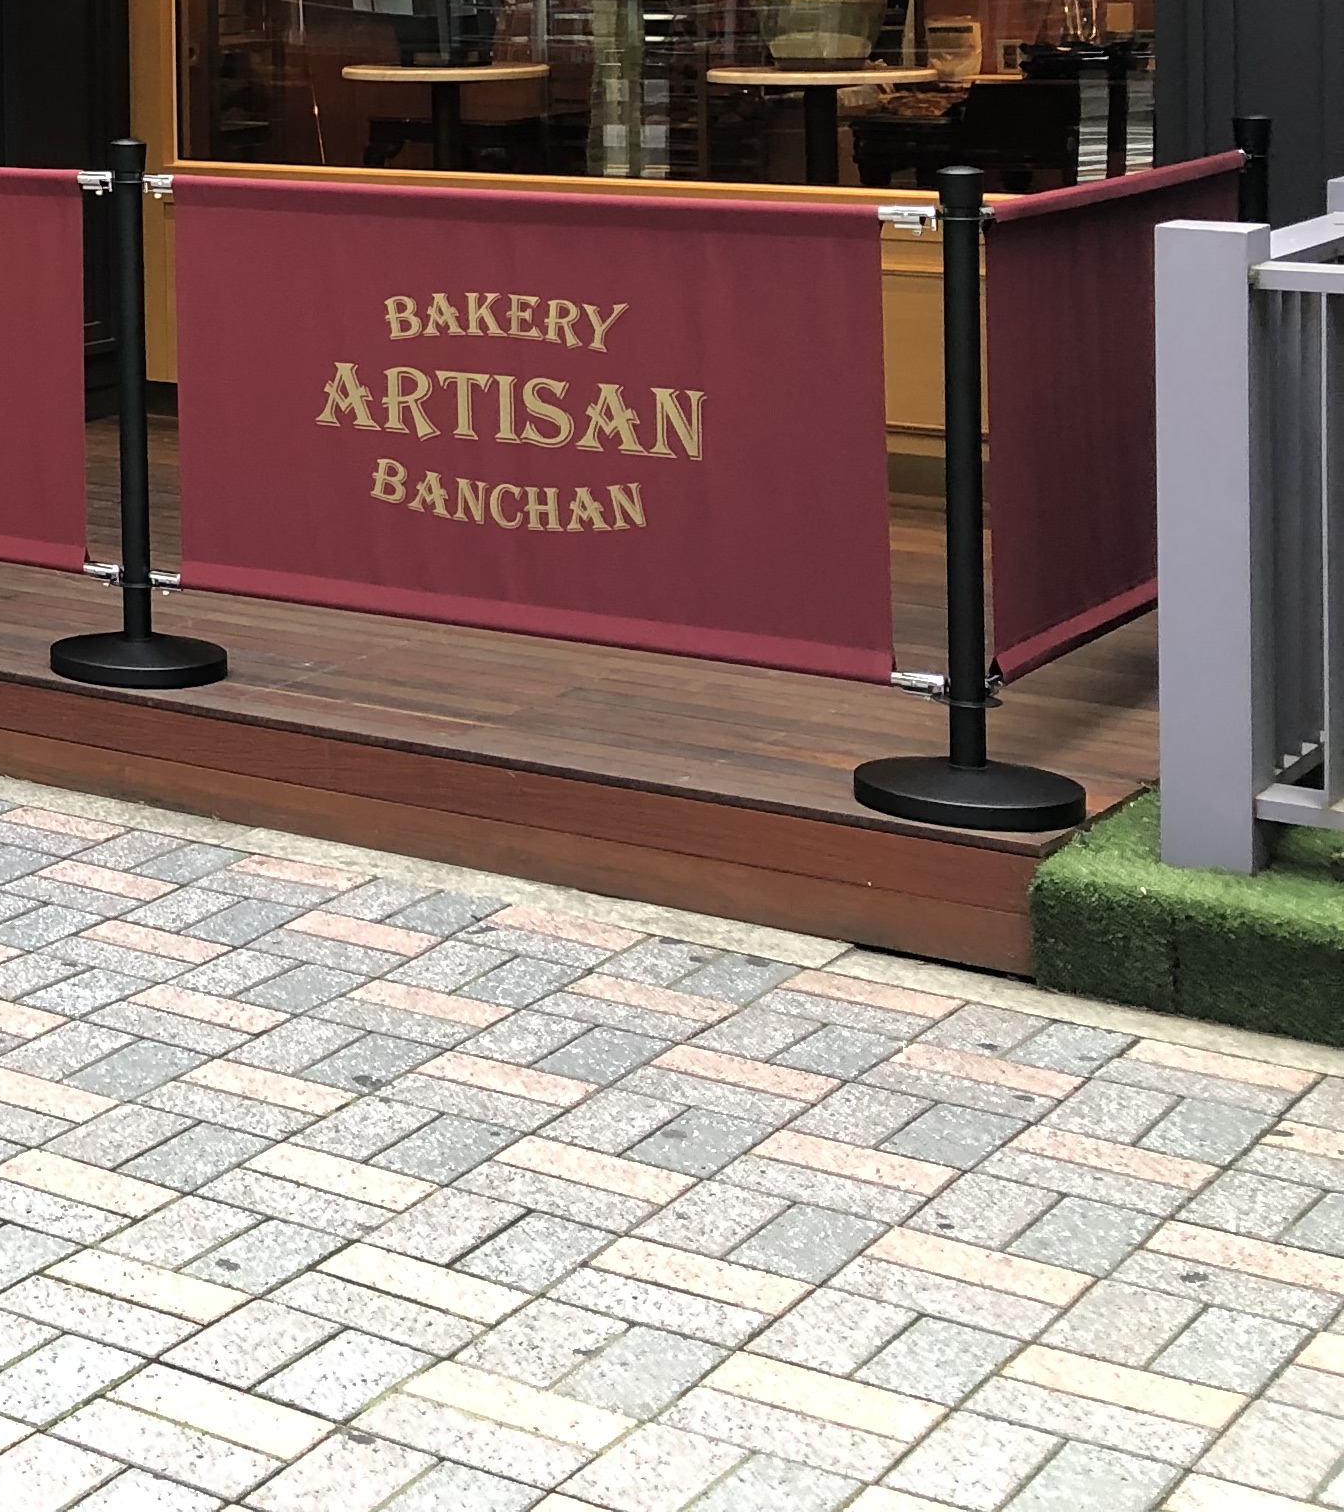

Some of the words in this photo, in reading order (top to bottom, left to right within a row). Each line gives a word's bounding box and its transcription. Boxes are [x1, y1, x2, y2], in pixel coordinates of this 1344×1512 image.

[384, 292, 629, 352] BAKERY
[316, 361, 707, 462] ARTISAN
[370, 458, 648, 533] BANCHAN
